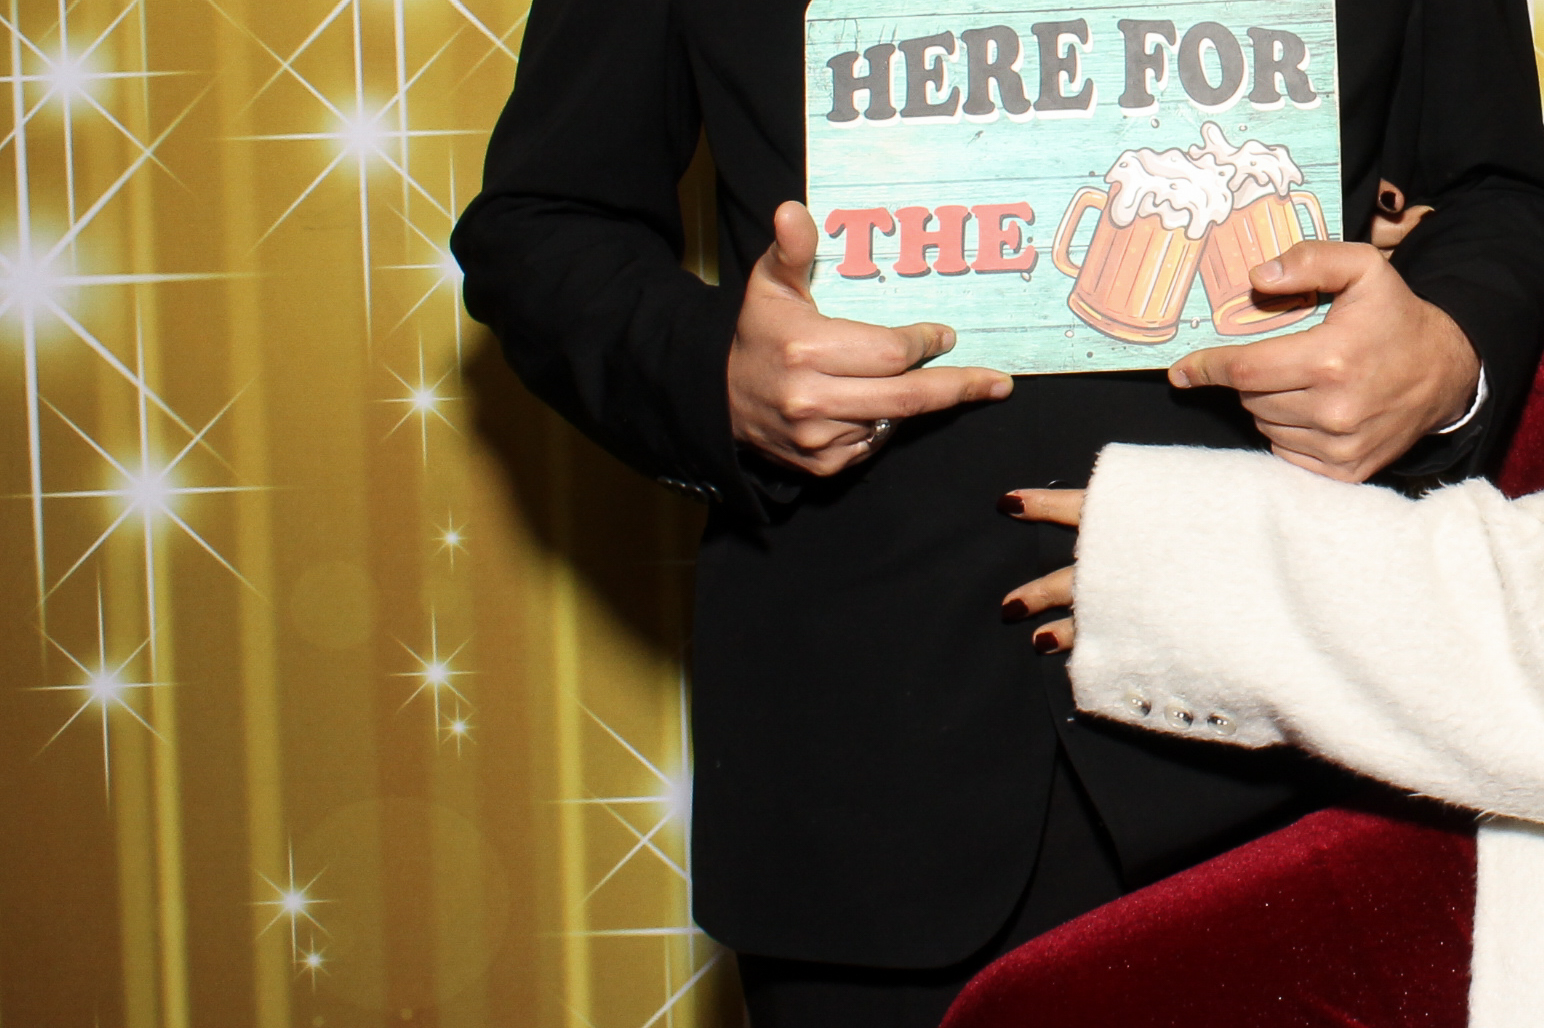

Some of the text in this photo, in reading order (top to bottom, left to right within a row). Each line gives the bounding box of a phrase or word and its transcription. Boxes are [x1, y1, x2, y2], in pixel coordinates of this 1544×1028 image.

[826, 18, 1319, 125] HERE FOR
[824, 202, 1038, 278] THE
